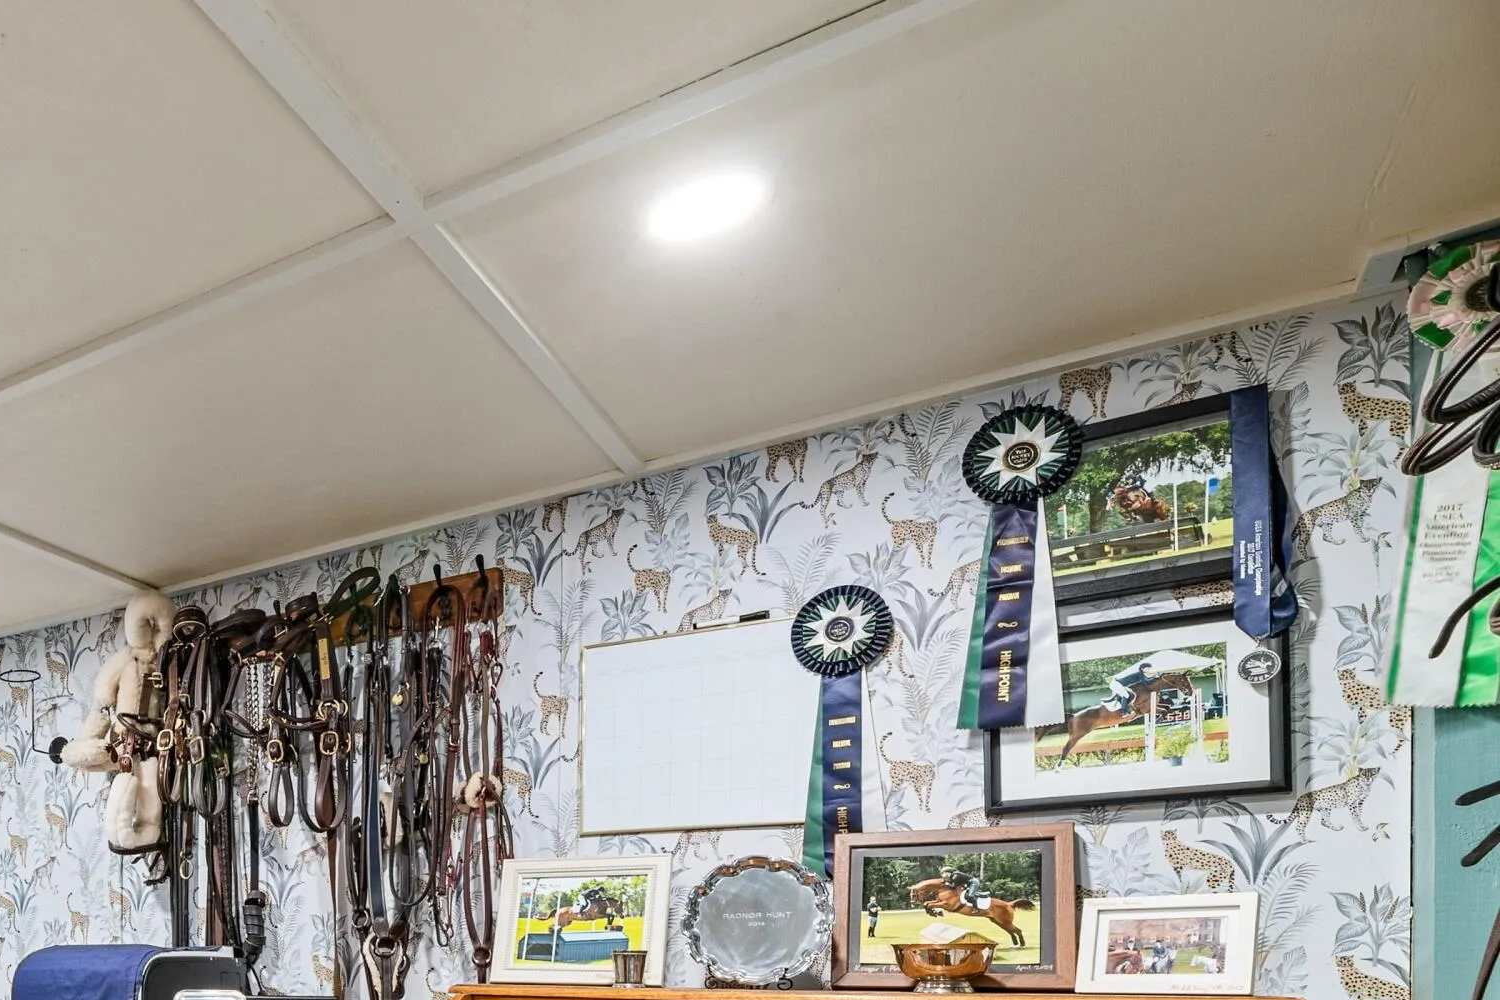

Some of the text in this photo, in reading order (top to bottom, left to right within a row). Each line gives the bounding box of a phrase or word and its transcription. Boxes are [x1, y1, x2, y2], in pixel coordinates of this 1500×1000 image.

[1436, 503, 1464, 512] 2017
[1425, 521, 1473, 531] American
[1424, 531, 1469, 540] Eventing
[998, 650, 1012, 703] HIGH POINT
[837, 806, 848, 827] HIGH
[722, 911, 792, 920] RADNOR HUNT
[1015, 964, 1032, 972] April
